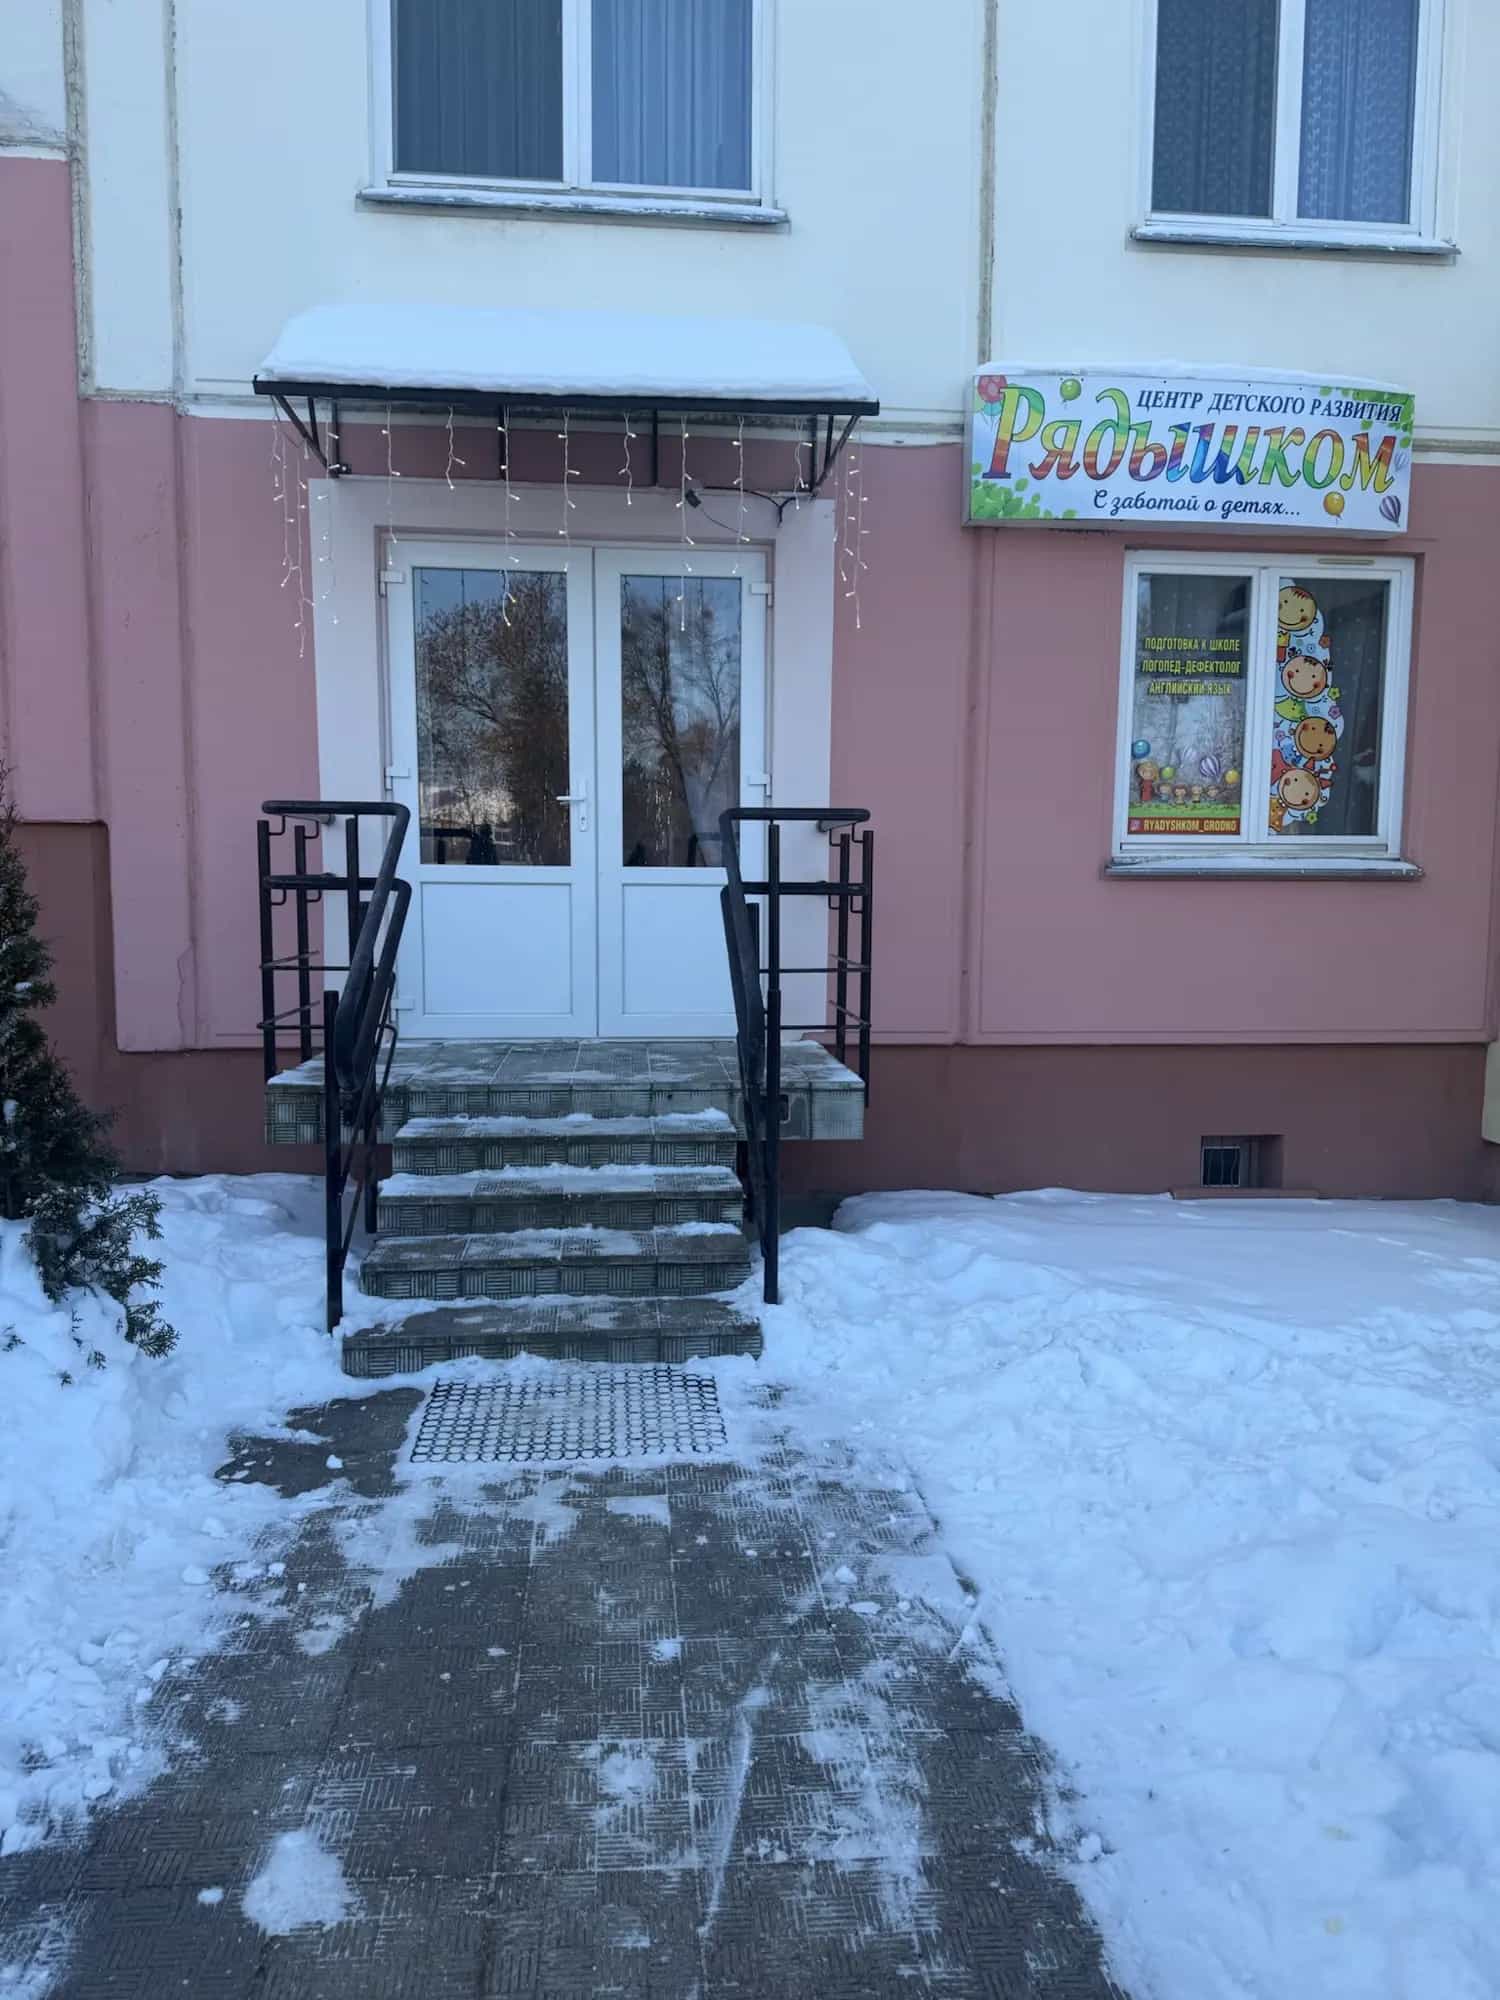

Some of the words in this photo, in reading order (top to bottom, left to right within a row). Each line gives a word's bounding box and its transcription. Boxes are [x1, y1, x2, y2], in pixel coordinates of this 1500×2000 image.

[1136, 390, 1202, 411] ЦЕНТР
[1207, 392, 1305, 415] ДЕТСКОГО
[1309, 398, 1402, 422] РАЗВИТИЯ
[981, 384, 1397, 494] Рядышком
[1093, 489, 1108, 509] С
[1110, 491, 1200, 516] заботой
[1204, 499, 1217, 512] о
[1221, 499, 1301, 520] детях...
[1144, 637, 1199, 652] ПОДГОТОВКА
[1201, 639, 1208, 651] К
[1209, 639, 1240, 652] ШКОЛЕ
[1142, 659, 1241, 675] ЛОГОПЕД-ДЕФЕКТОЛОГ
[1207, 683, 1233, 696] ЯЗЫК
